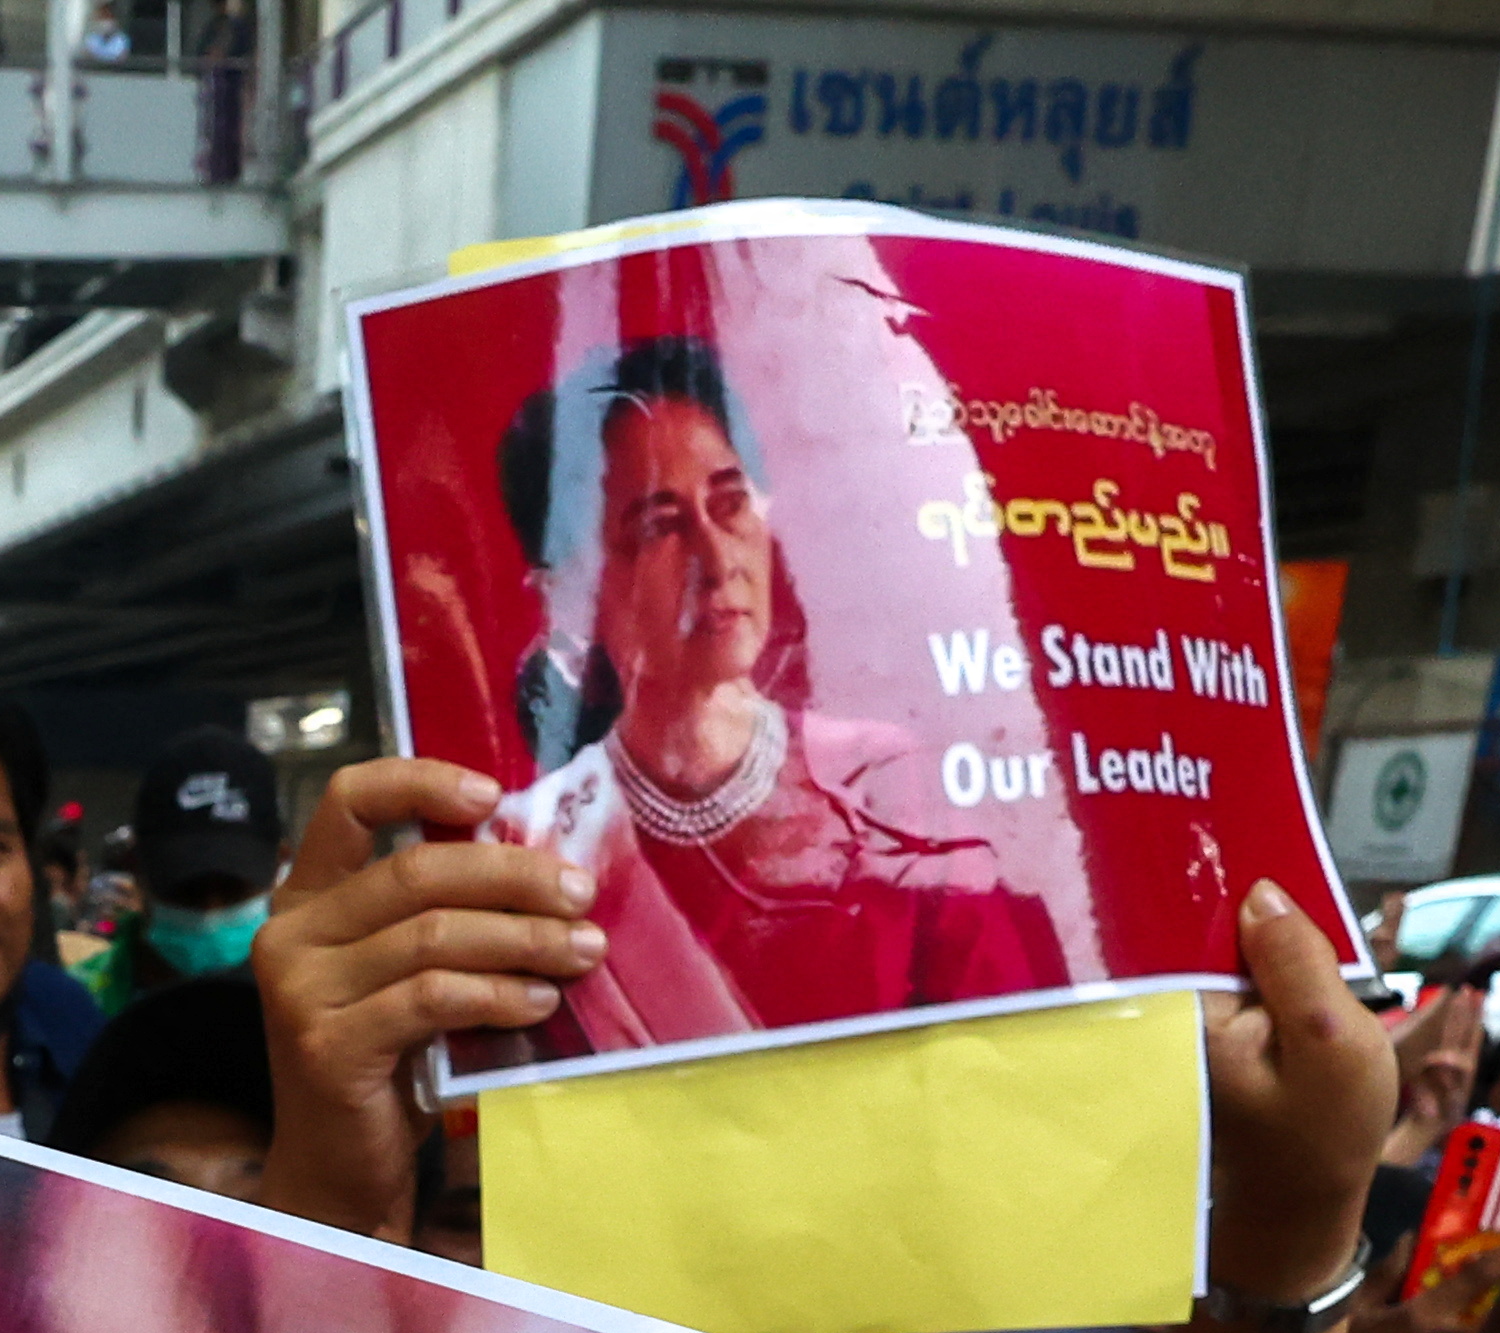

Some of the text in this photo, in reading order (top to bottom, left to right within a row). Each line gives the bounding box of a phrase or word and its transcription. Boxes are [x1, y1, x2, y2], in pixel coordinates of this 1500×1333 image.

[927, 624, 1269, 708] We Stand With
[942, 730, 1213, 807] Our Leader
